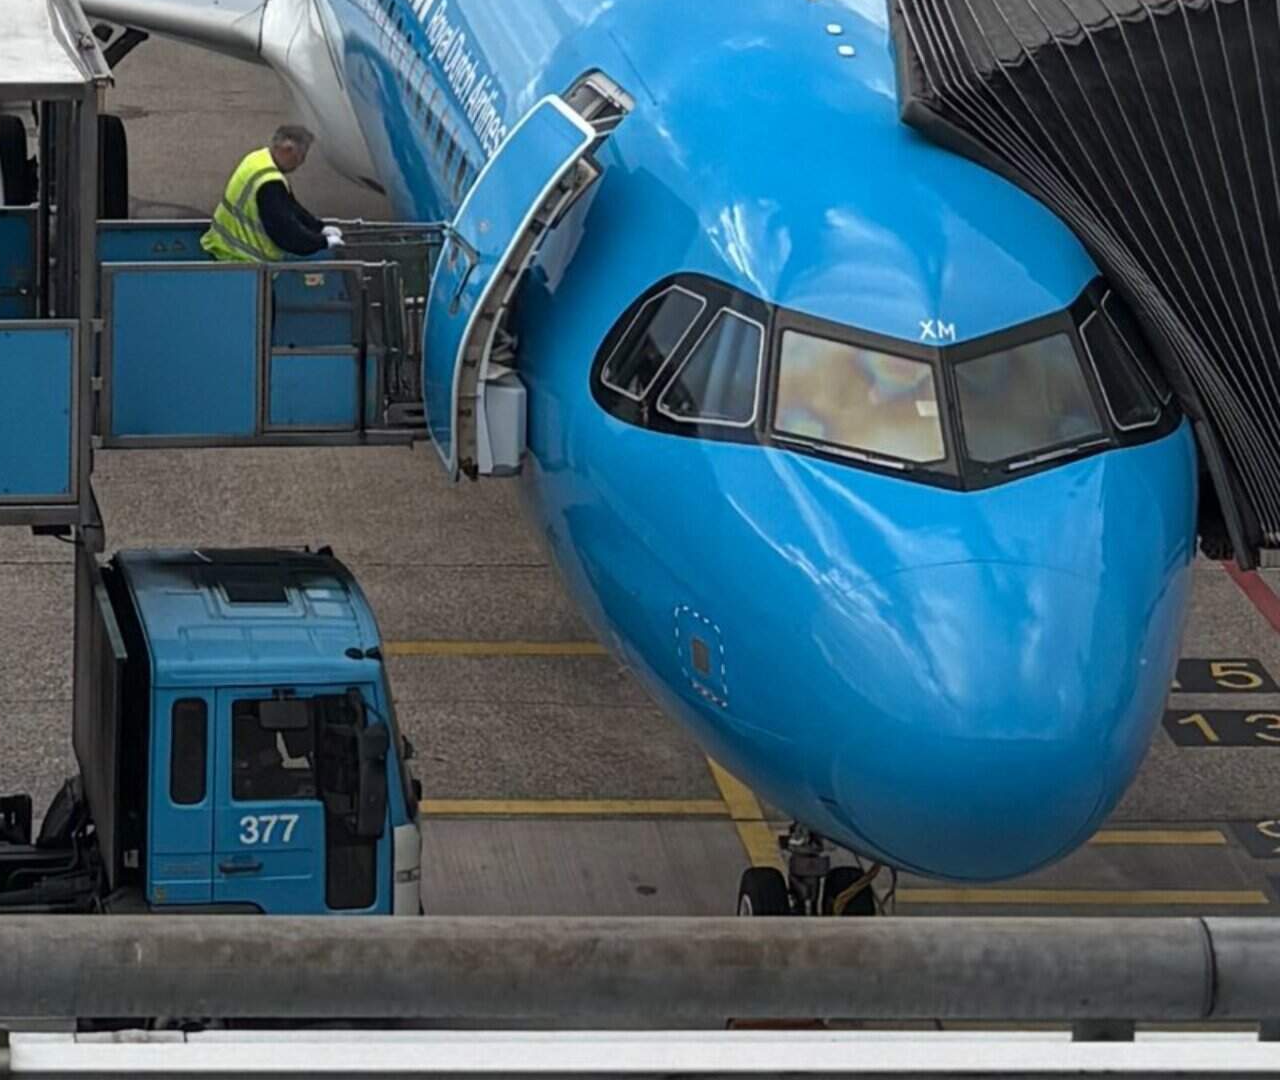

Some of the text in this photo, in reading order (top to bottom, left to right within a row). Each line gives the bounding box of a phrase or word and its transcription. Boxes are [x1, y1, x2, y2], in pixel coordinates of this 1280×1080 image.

[443, 32, 480, 105] Dutch
[464, 74, 507, 159] Airlines
[919, 319, 957, 342] XM
[239, 813, 299, 845] 377
